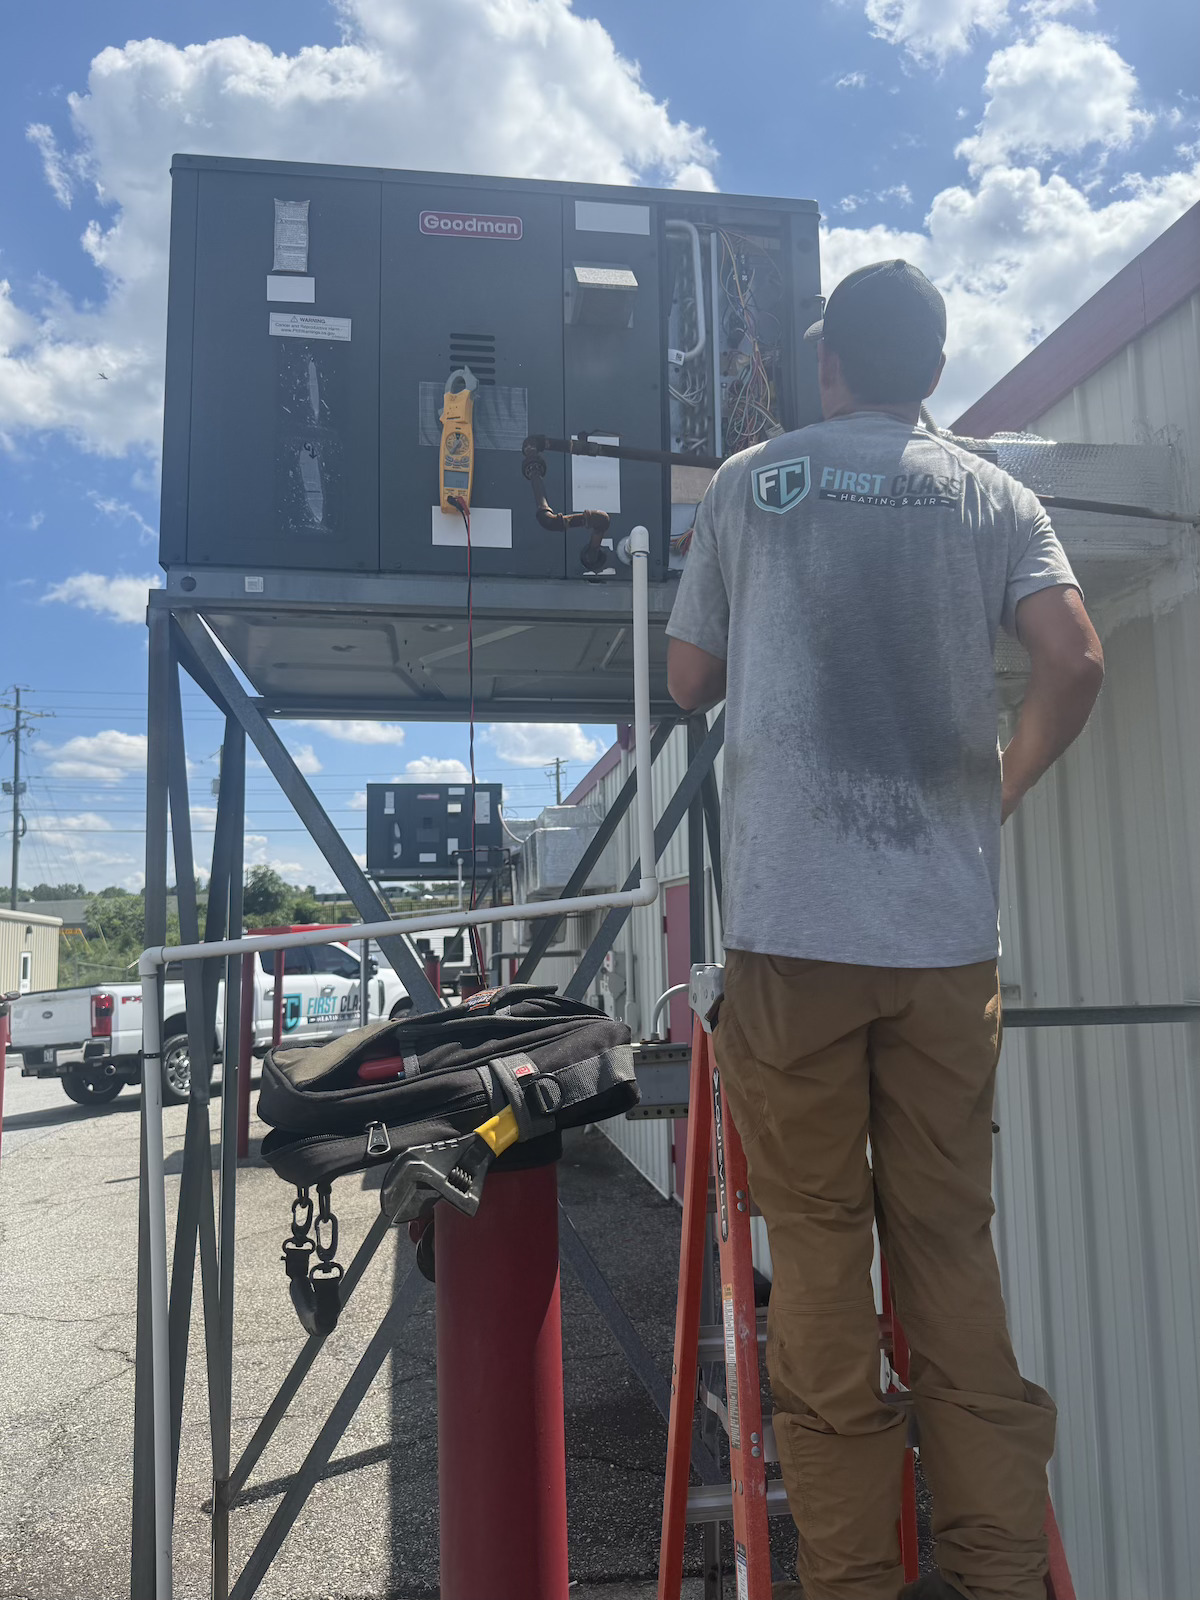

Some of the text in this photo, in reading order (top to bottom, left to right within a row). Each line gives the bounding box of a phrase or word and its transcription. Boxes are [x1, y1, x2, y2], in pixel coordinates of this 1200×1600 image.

[423, 214, 518, 235] Goodman
[759, 464, 802, 505] FC
[820, 466, 962, 500] FIRST CLASS
[840, 493, 937, 507] HEATING & AIR
[307, 996, 338, 1015] FIRST
[715, 1092, 727, 1237] LOUISVILLE
